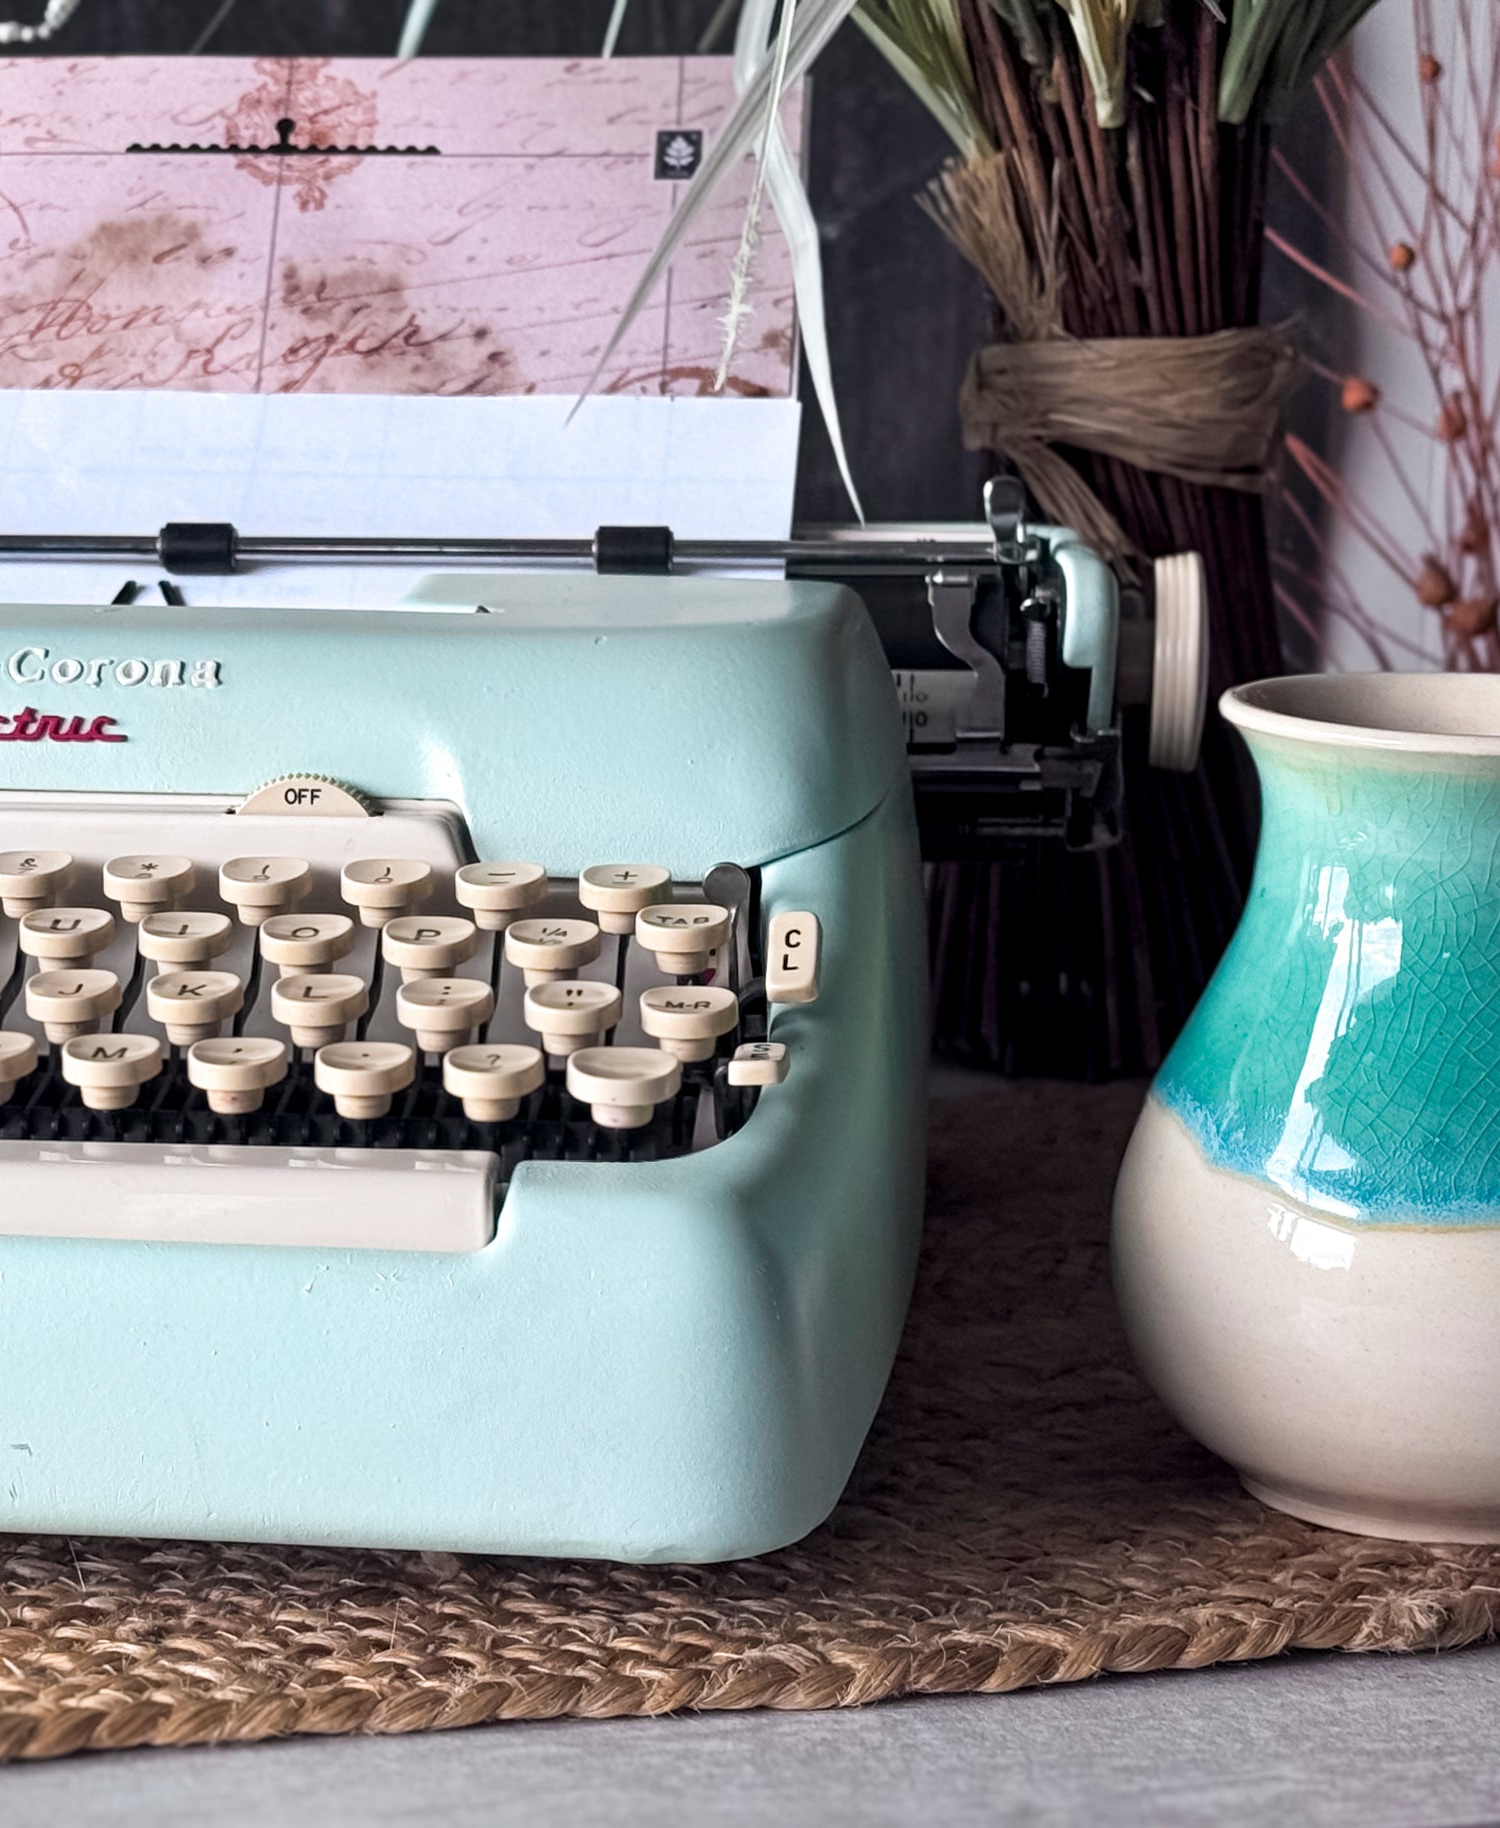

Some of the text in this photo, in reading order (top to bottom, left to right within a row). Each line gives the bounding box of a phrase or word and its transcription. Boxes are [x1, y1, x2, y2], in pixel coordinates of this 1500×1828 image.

[283, 788, 323, 806] OFF
[50, 919, 82, 931] U
[290, 926, 320, 939] O
[412, 928, 442, 942] P
[57, 982, 84, 996] J
[176, 984, 208, 997] K
[301, 985, 329, 999] L
[91, 1046, 129, 1059] M
